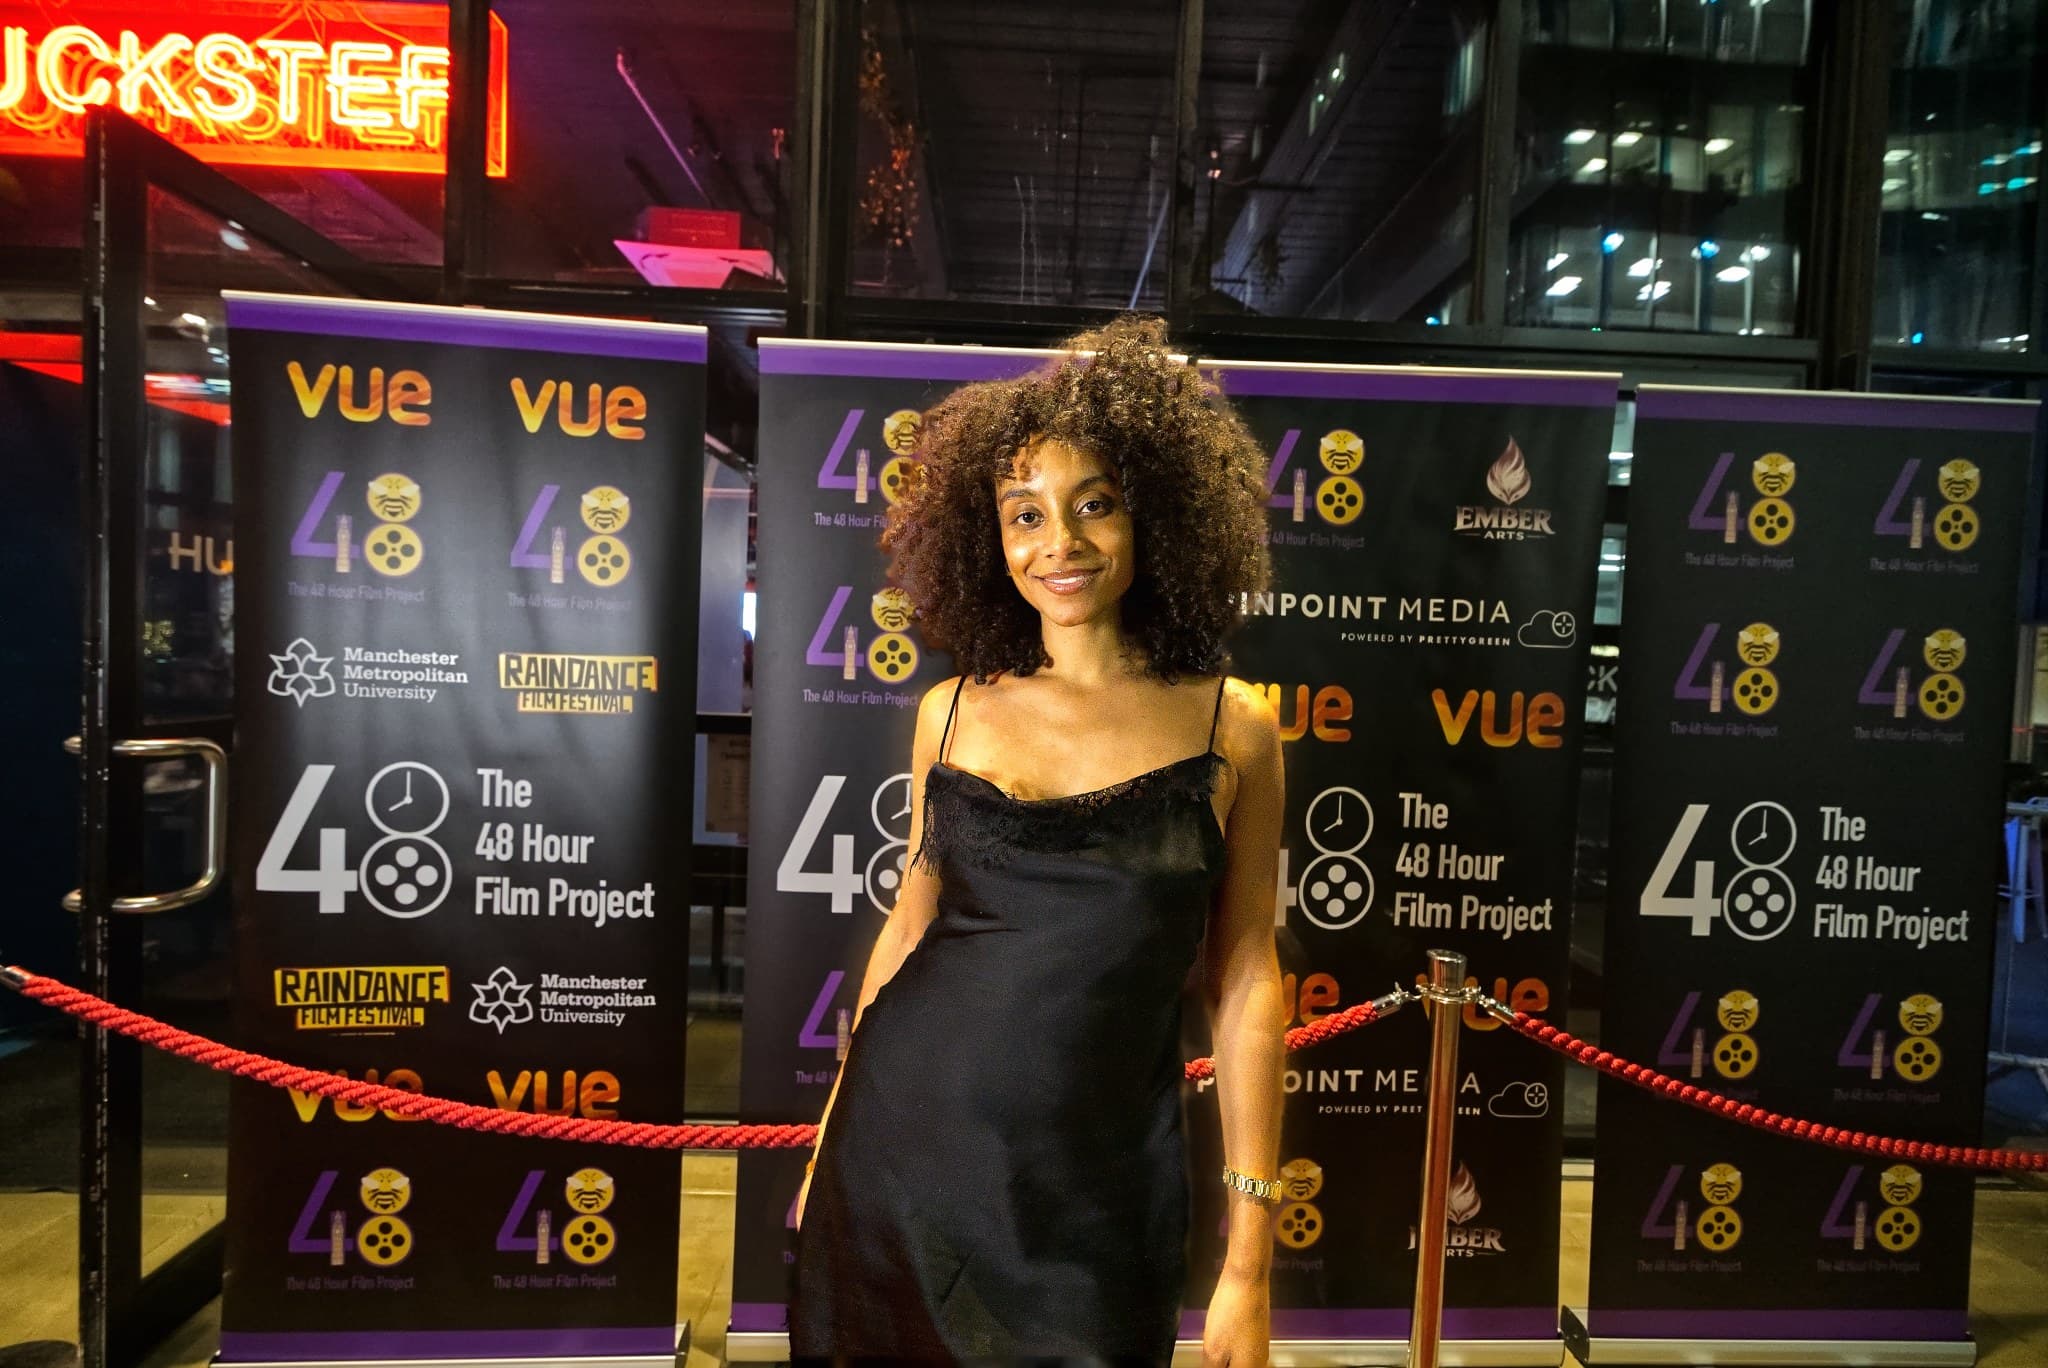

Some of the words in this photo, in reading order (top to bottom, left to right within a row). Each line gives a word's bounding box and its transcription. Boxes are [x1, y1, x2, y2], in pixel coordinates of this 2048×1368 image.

[814, 512, 831, 526] The
[834, 513, 846, 526] 48
[848, 514, 870, 527] Hour
[873, 515, 889, 528] Fil
[1454, 506, 1555, 534] EMBER
[1484, 531, 1525, 541] ARTS
[1229, 591, 1387, 620] INPOINT
[1400, 599, 1511, 624] MEDIA
[1341, 632, 1394, 643] POWERED
[1400, 635, 1413, 643] BY
[1419, 635, 1511, 646] PRETTYGREEN
[344, 647, 459, 666] Manchester
[344, 666, 469, 685] Metropolitan
[503, 654, 656, 692] RAINDANCE
[344, 684, 437, 703] University
[521, 692, 555, 709] FILM
[559, 693, 633, 712] FESTIVAL
[803, 689, 820, 702] The
[822, 690, 835, 702] 48
[837, 691, 860, 704] Hour
[862, 691, 882, 705] Film
[885, 692, 918, 708] Project
[1253, 682, 1353, 742] ue
[477, 767, 532, 808] The
[1399, 792, 1449, 829] The
[1820, 806, 1866, 842] The
[475, 822, 513, 861] 48
[523, 824, 595, 864] Hour
[1396, 843, 1429, 878] 48
[1438, 844, 1505, 881] Hour
[1815, 855, 1847, 889] 48
[1855, 856, 1921, 893] Hour
[475, 876, 540, 916] Film
[548, 878, 656, 927] Project
[1394, 892, 1452, 929] Film
[1461, 893, 1553, 940] Project
[1814, 904, 1867, 939] Film
[1876, 905, 1969, 950] Project
[280, 969, 446, 1004] RAINDANCE
[540, 974, 647, 990] Manchester
[540, 991, 657, 1009] Metropolitan
[301, 1007, 340, 1026] FILM
[344, 1006, 424, 1026] FESTIVAL
[540, 1010, 625, 1027] University
[1197, 1069, 1363, 1093] POINT
[1375, 1070, 1480, 1094] MEA
[1318, 1105, 1371, 1114] POWERED
[1376, 1105, 1388, 1113] BY
[1393, 1105, 1480, 1115] PRETEEN
[1408, 1224, 1506, 1252] BER
[1447, 1249, 1474, 1257] RTS
